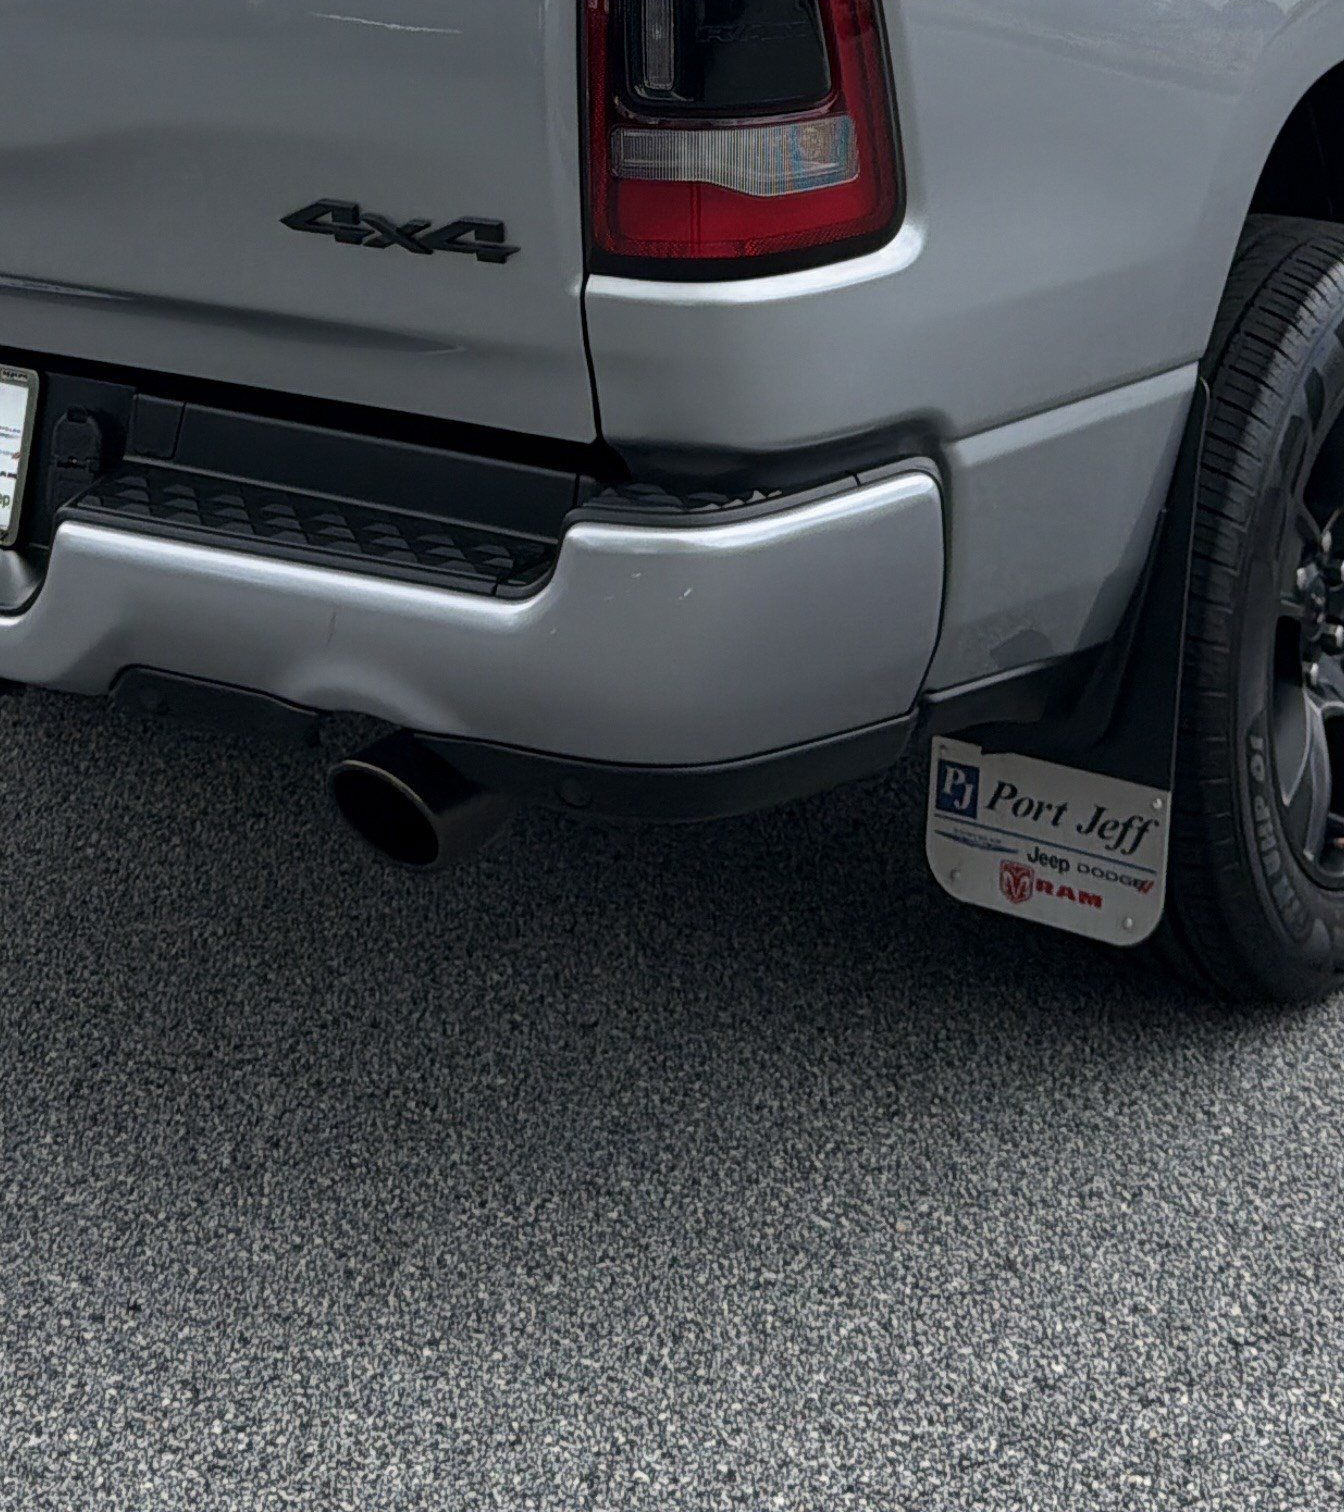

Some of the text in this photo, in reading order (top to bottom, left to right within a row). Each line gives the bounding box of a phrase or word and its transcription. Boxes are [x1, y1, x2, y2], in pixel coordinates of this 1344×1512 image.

[942, 764, 974, 811] PJ
[985, 780, 1160, 856] Port Jeff
[1026, 846, 1144, 891] Jeep DODGE
[1035, 879, 1104, 910] RAM
